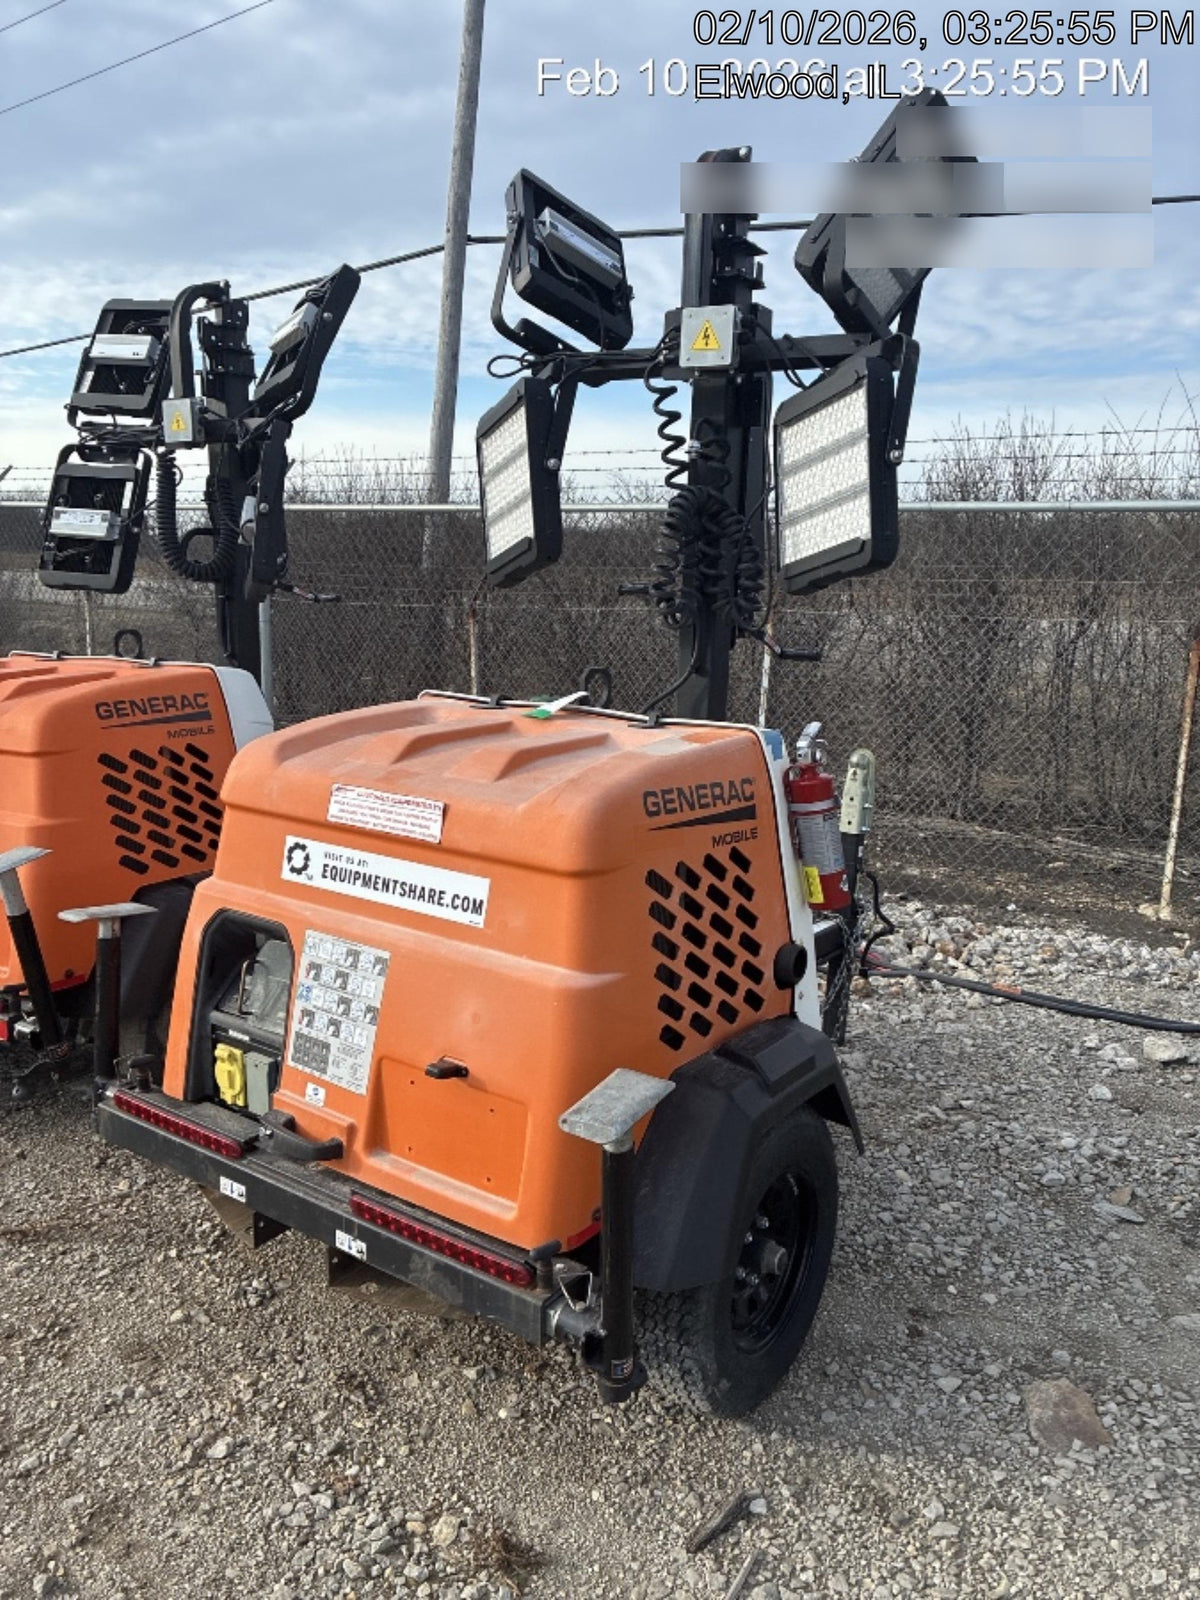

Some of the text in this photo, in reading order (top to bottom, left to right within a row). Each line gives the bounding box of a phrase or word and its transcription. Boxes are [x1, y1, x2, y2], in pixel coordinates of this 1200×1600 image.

[95, 692, 209, 721] GENERAC
[167, 725, 215, 739] MOBILE
[642, 777, 755, 818] GENERAC
[711, 827, 759, 849] MOBILE
[321, 863, 485, 916] EQUIPMENTSHARE.COM
